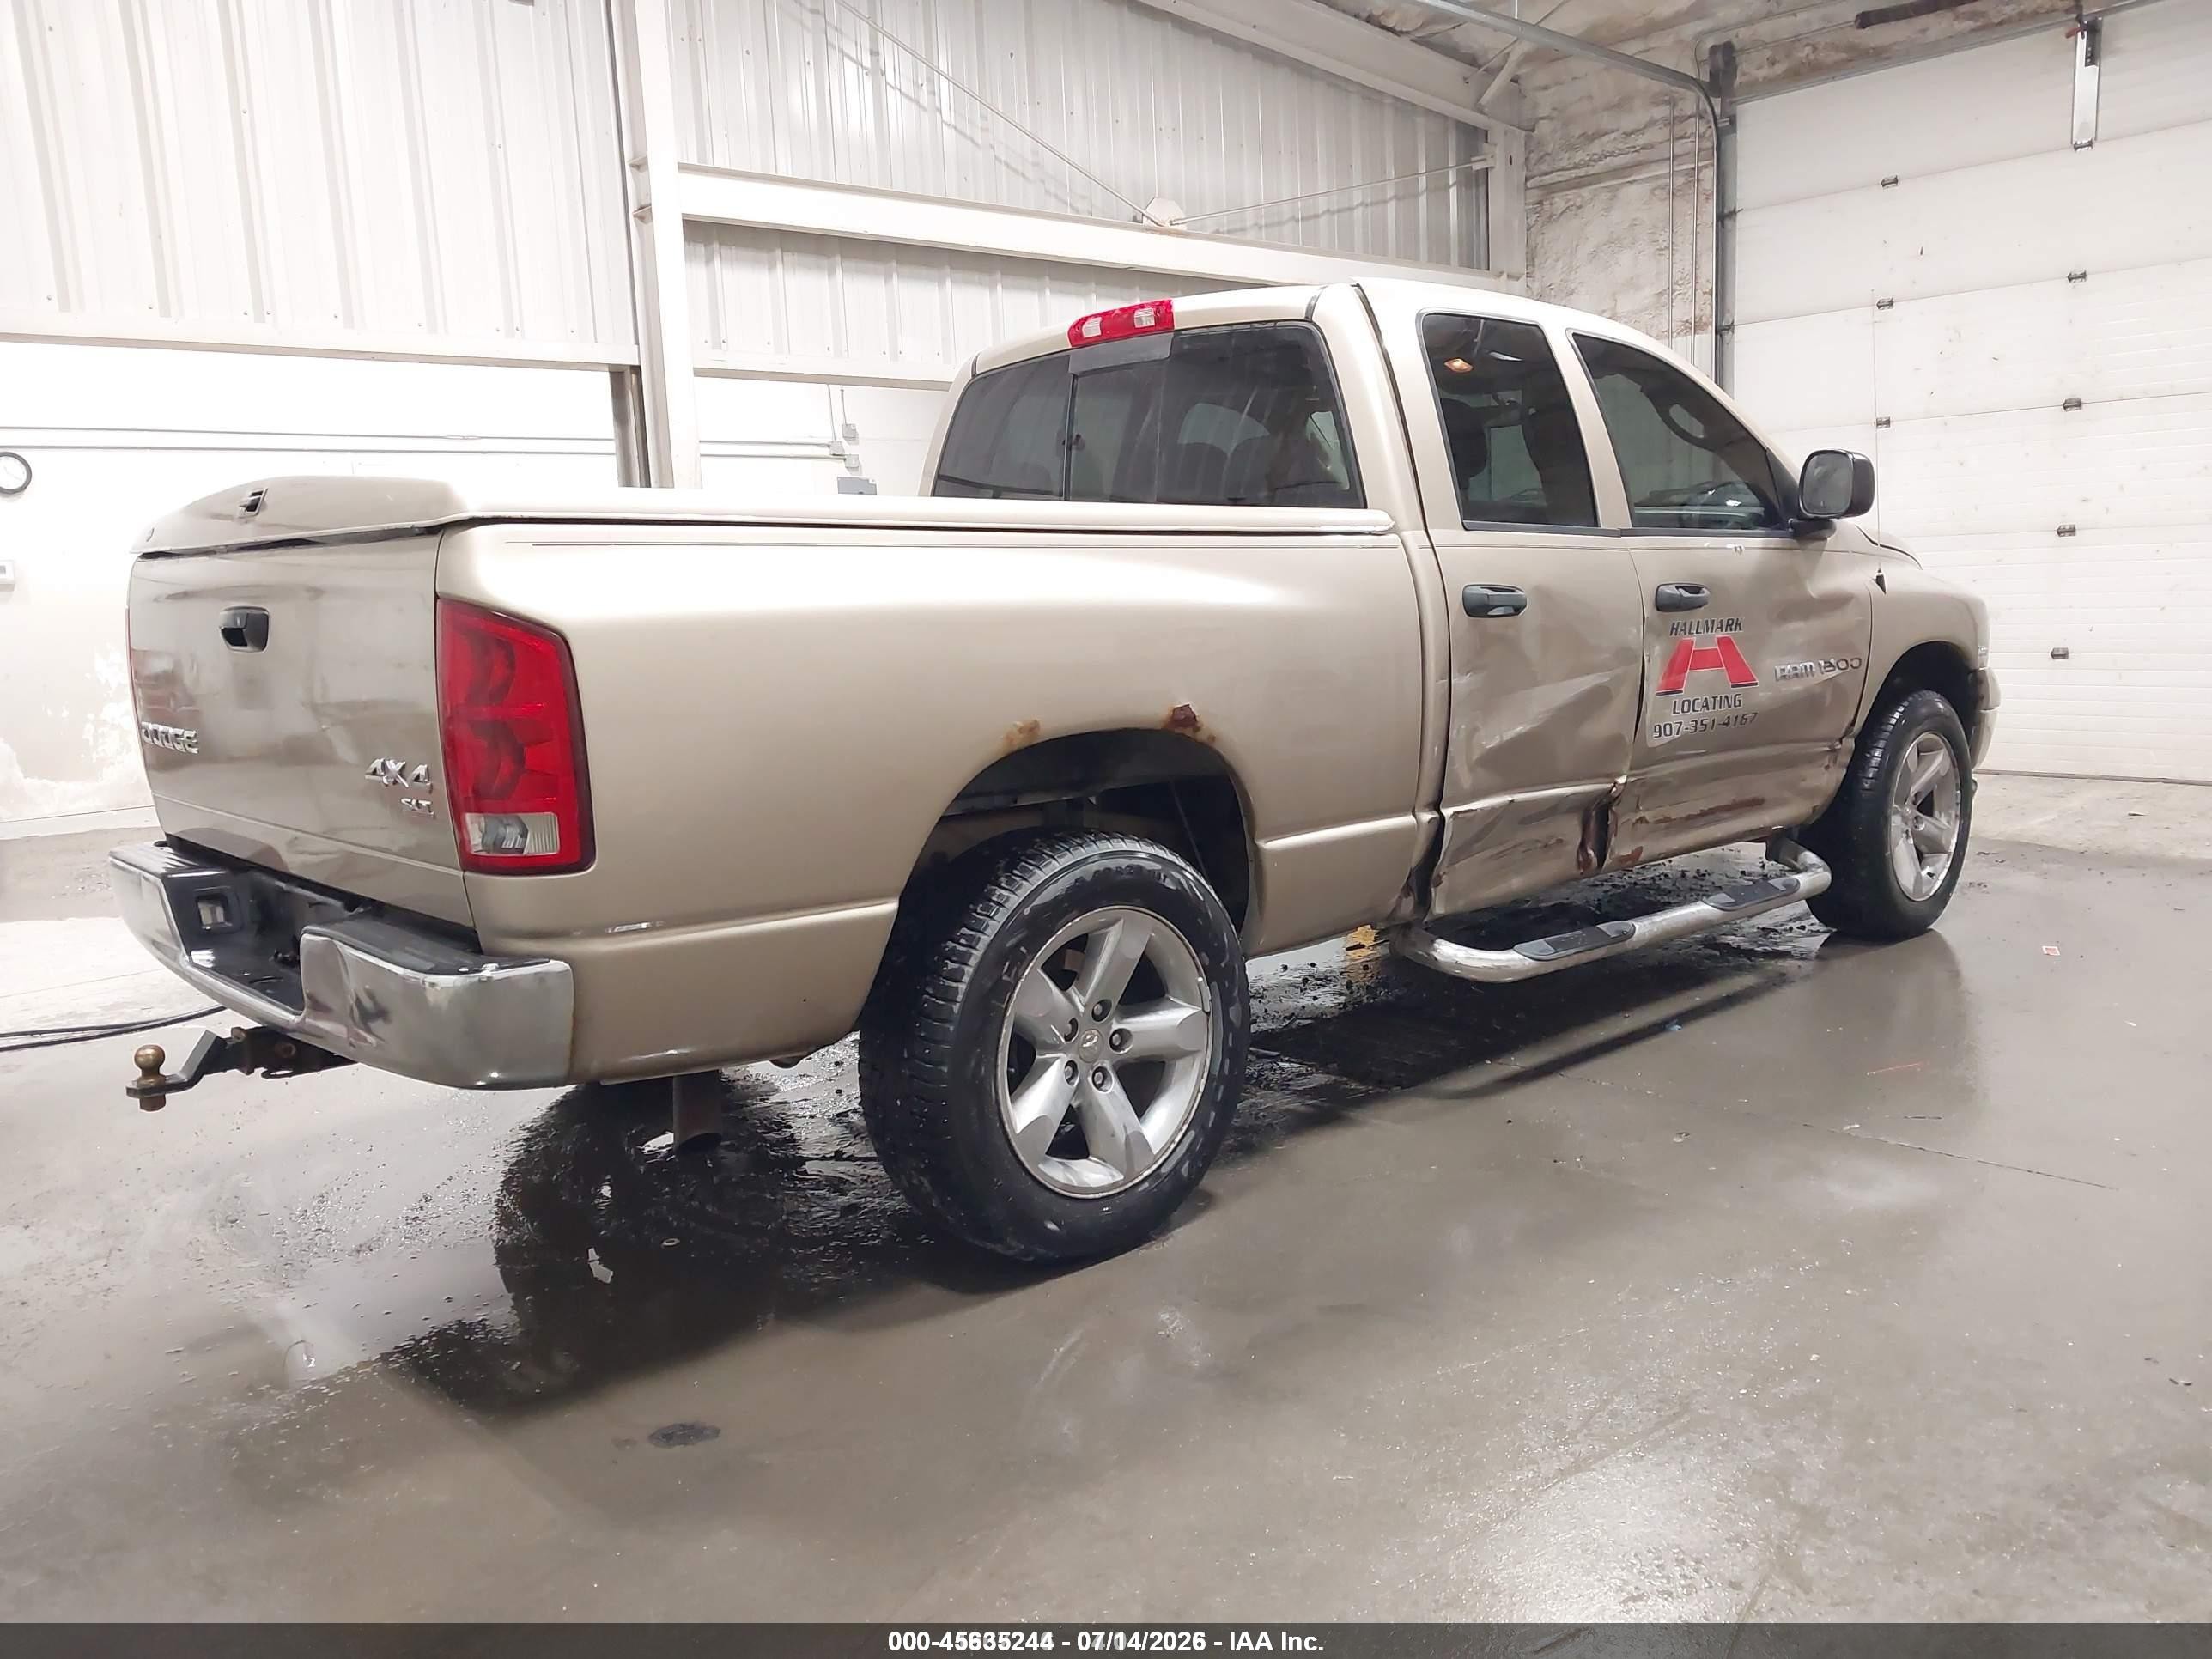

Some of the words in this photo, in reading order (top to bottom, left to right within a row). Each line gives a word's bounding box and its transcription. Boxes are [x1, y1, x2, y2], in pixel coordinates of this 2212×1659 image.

[1669, 617, 1744, 636] HALLMARK
[1774, 661, 1816, 682] RAM
[1818, 657, 1863, 675] 1500
[1671, 693, 1743, 716] LOCATING
[141, 721, 200, 754] DODGE
[1653, 712, 1759, 739] 907-351-4167
[400, 798, 435, 817] SLT
